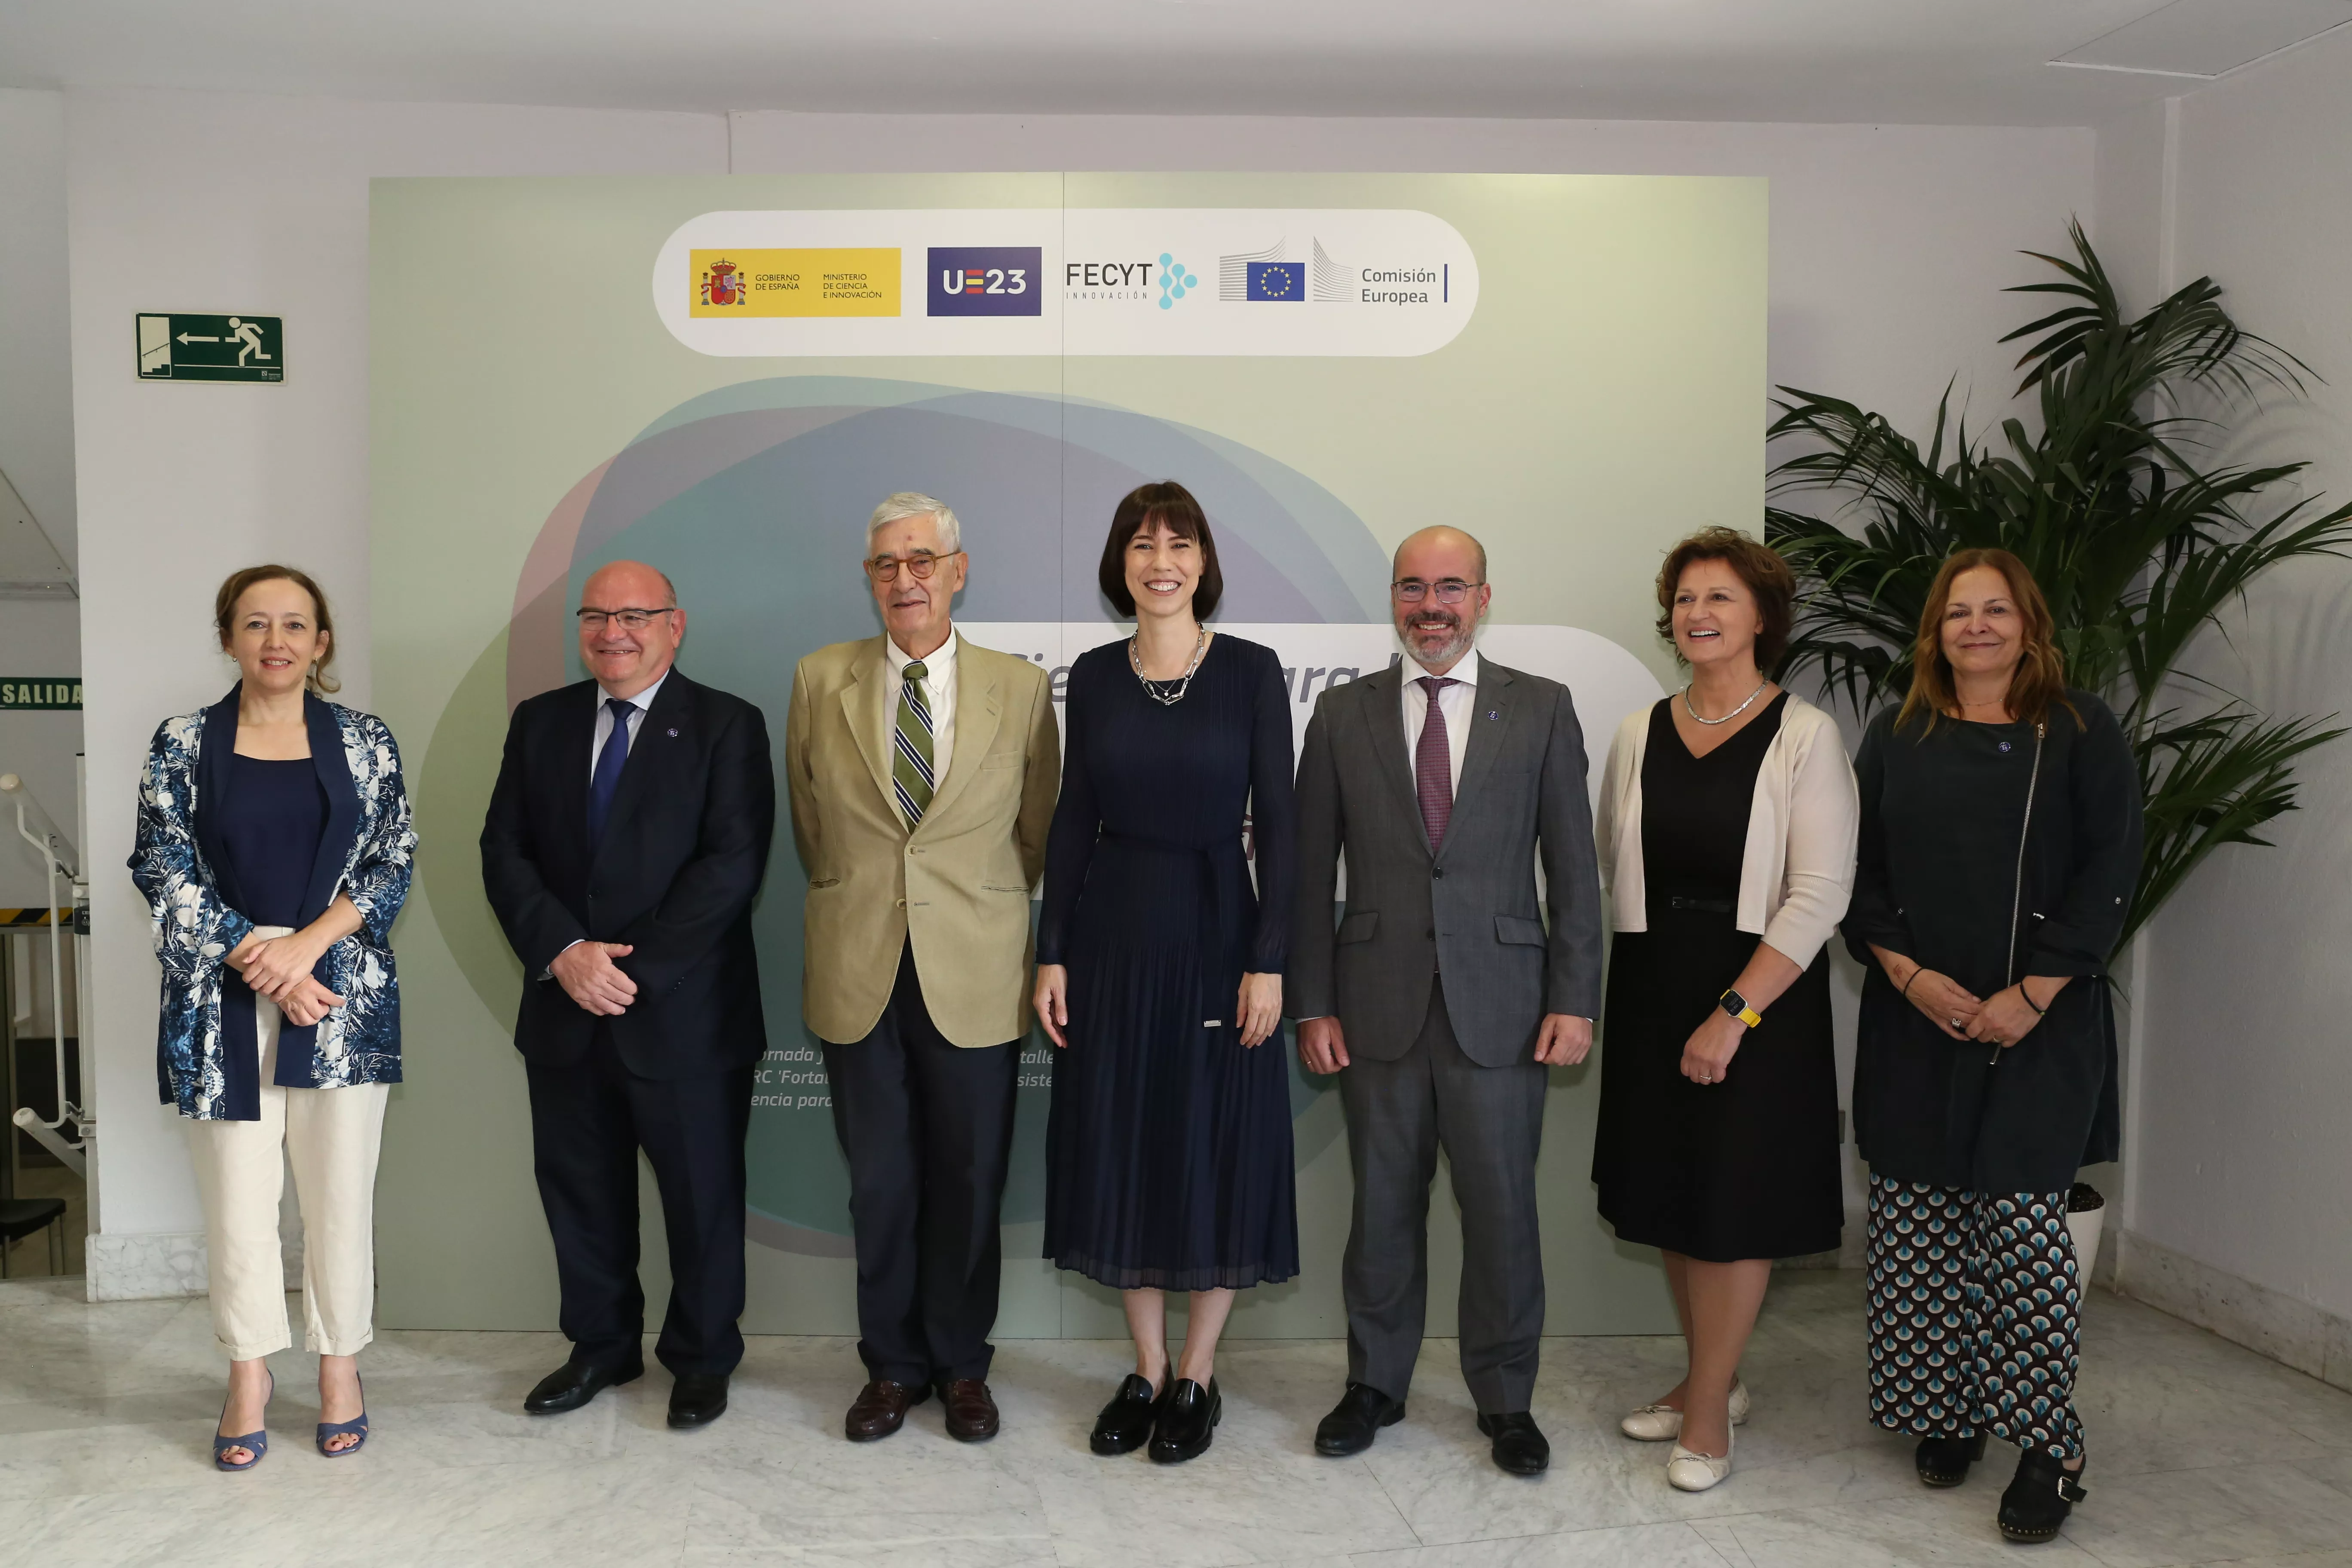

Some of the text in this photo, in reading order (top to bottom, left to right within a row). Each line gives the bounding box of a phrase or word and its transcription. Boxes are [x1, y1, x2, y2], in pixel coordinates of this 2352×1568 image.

[943, 269, 1026, 295] UE23
[1067, 263, 1153, 286] FECYT
[1362, 268, 1436, 282] Comisión
[769, 282, 799, 290] ESPAÑA
[830, 290, 882, 298] INNOVACIÓN
[1066, 291, 1147, 299] INNOVACIÓN
[1362, 289, 1428, 306] Europea
[2, 684, 83, 704] SALIDA
